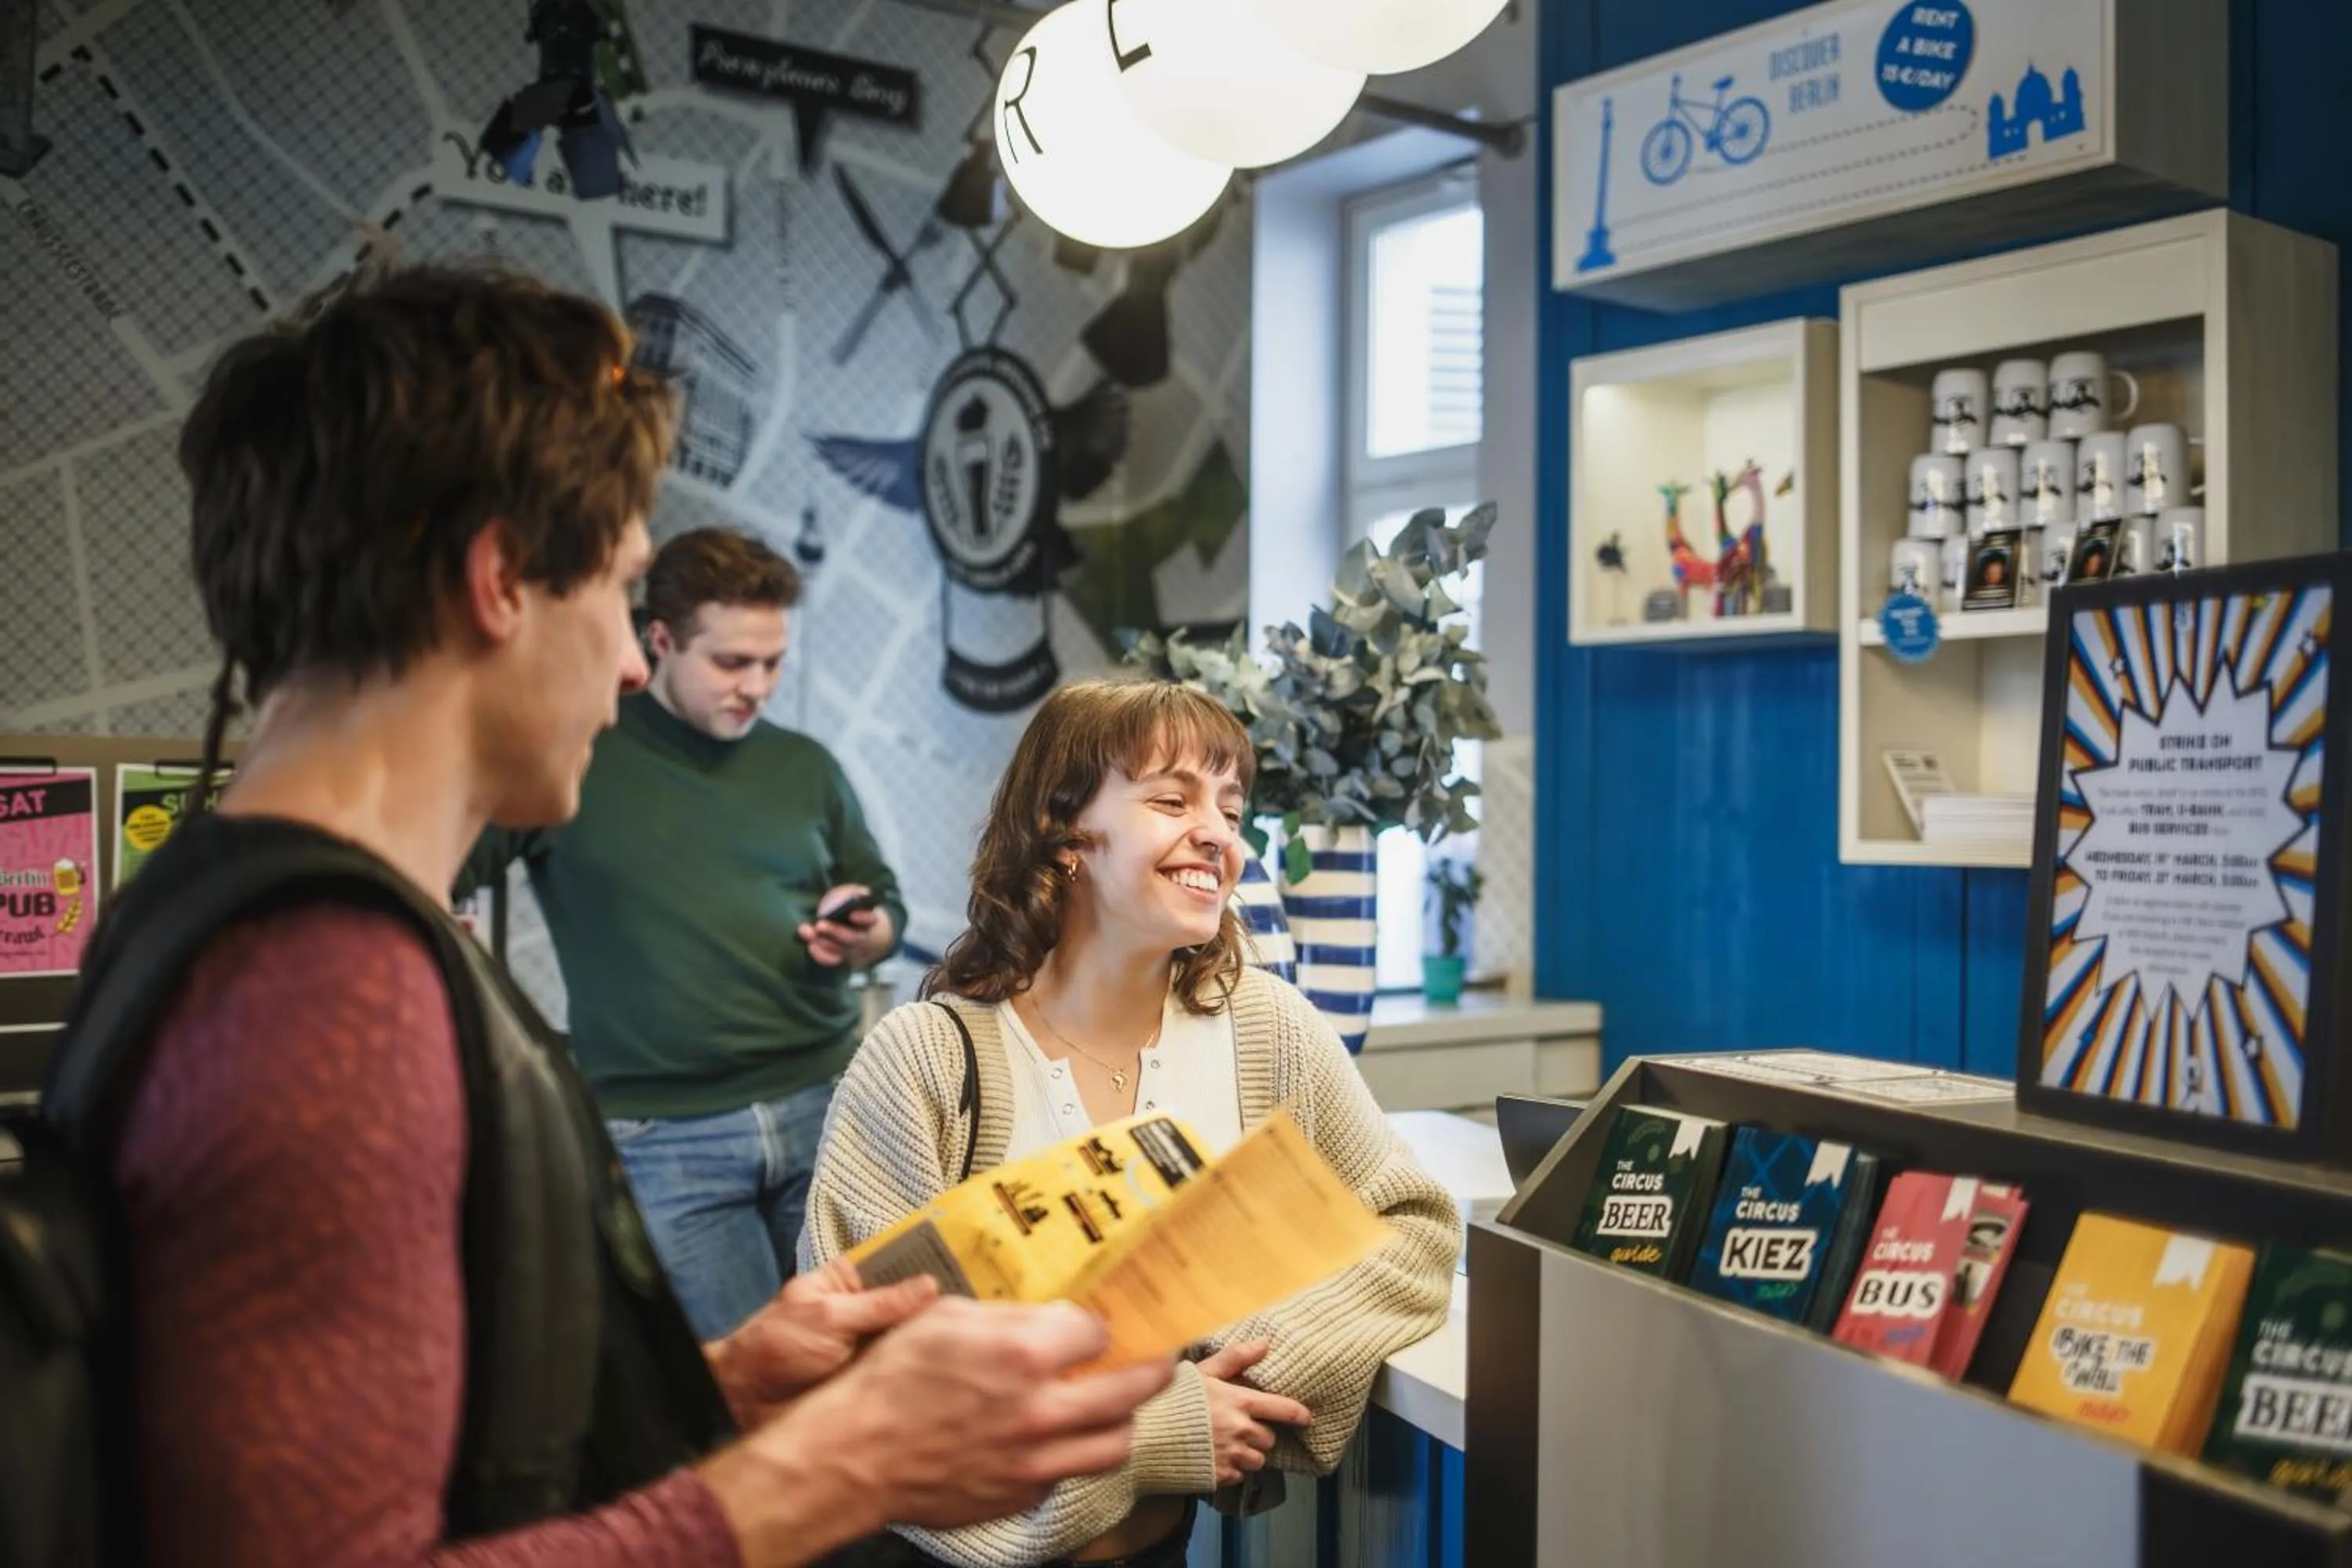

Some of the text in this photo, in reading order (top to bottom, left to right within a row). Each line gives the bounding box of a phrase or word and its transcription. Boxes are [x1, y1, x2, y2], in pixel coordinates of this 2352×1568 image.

[1911, 6, 1959, 28] RENT
[1769, 33, 1840, 81] DISCOVER
[1896, 36, 1957, 60] A BIKE
[1004, 45, 1044, 164] R
[1789, 73, 1840, 113] BERLIN
[2159, 734, 2232, 750] STRIKE ON
[2129, 755, 2263, 773] PUBLIC TRANSPORT
[1617, 1160, 1635, 1171] THE
[1612, 1173, 1664, 1191] CIRCUS
[1741, 1185, 1762, 1200] THE
[1602, 1202, 1668, 1231] BEER
[1736, 1200, 1801, 1223] CIRCUS
[1610, 1244, 1662, 1264] guide
[1726, 1236, 1809, 1272] KIEZ
[1873, 1241, 1935, 1263] CIRCUS
[1858, 1277, 1940, 1310] BUS
[2054, 1298, 2144, 1330] CIRCUS
[2258, 1319, 2293, 1339] THE
[2115, 1339, 2151, 1366] THE
[2249, 1386, 2352, 1438] BEE
